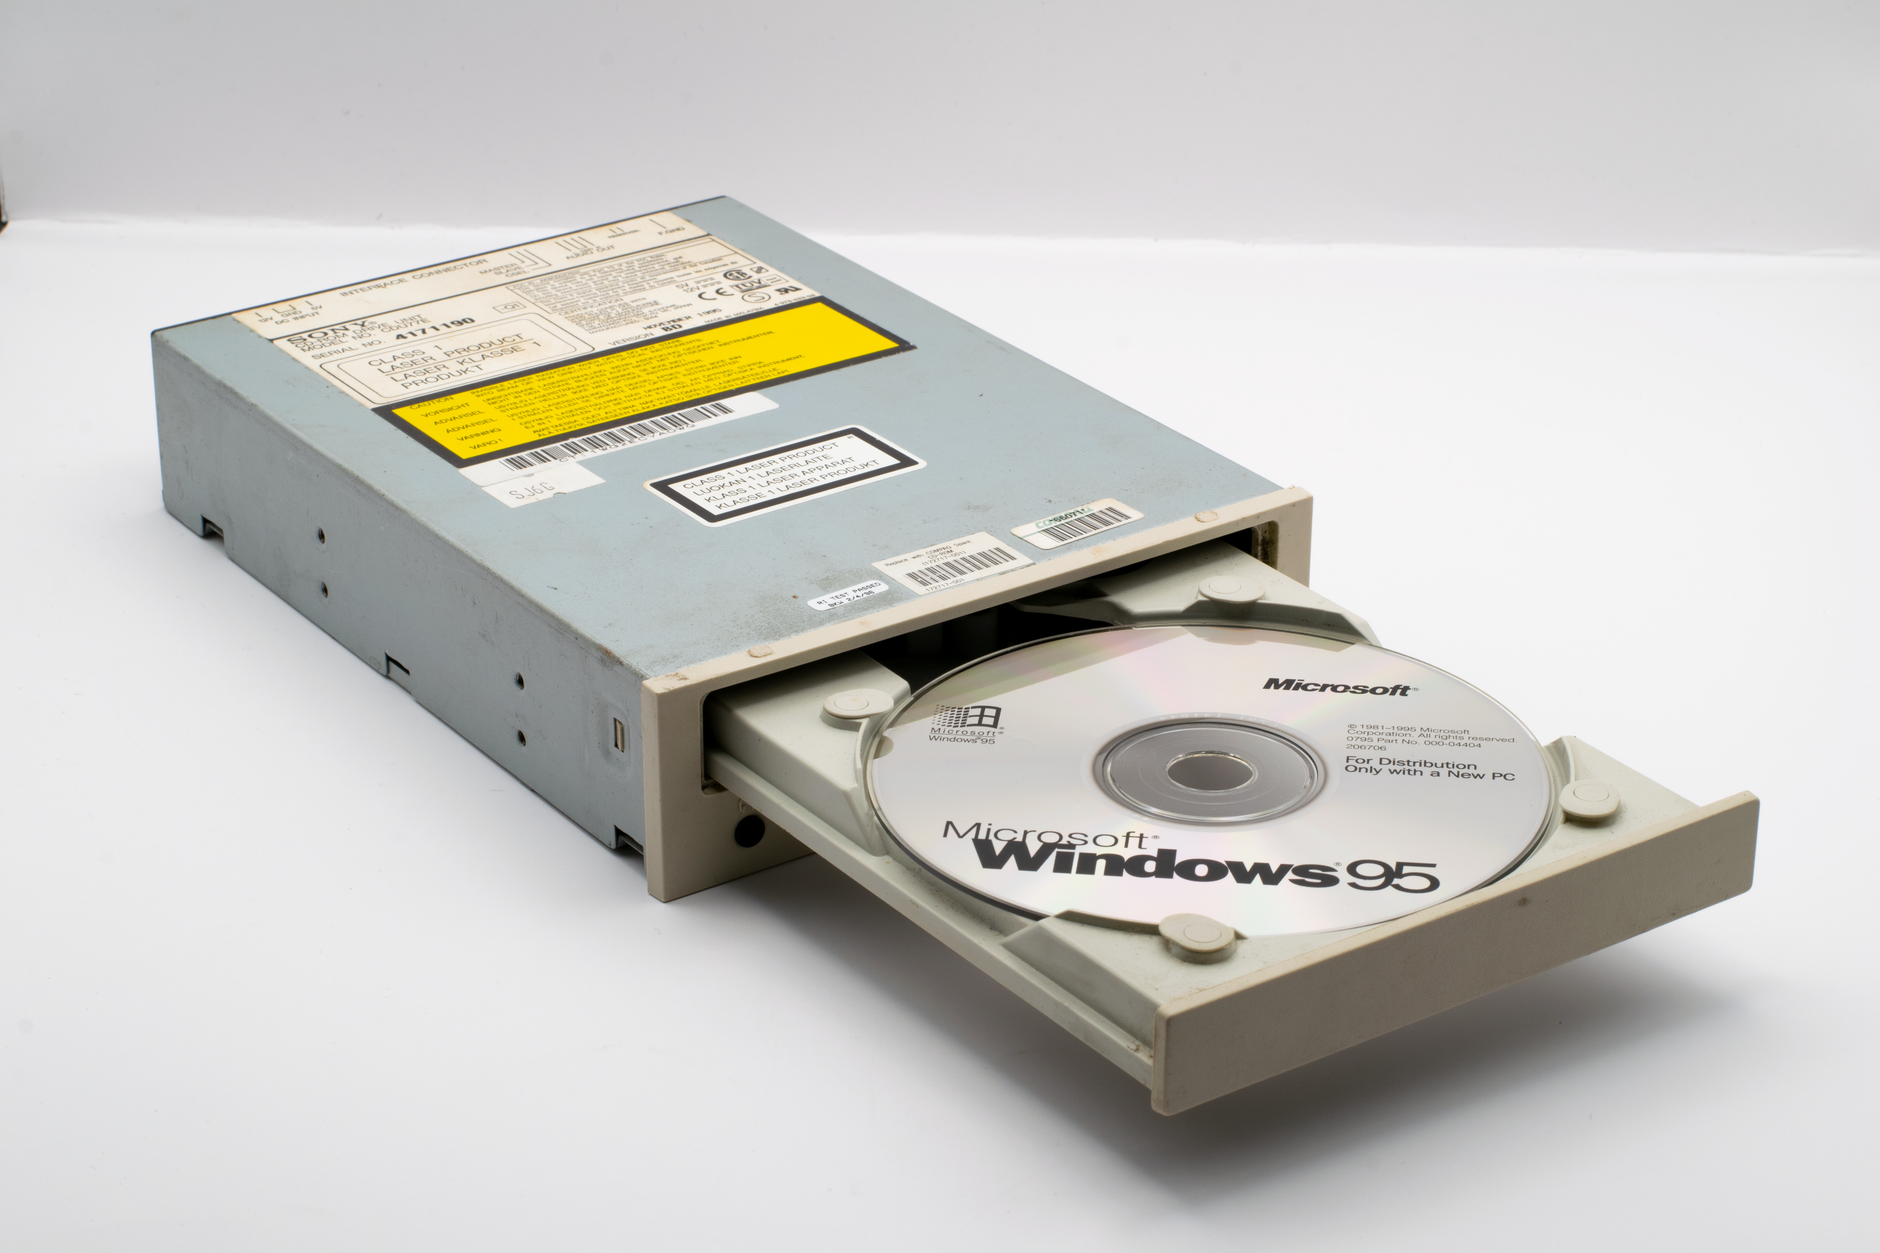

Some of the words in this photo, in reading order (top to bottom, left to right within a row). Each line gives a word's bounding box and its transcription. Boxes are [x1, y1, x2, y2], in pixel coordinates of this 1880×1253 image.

[479, 263, 517, 274] MASTER
[340, 278, 407, 297] INTERFACE
[412, 259, 488, 279] CONNECTOR
[292, 312, 319, 321] INPUT
[643, 316, 691, 330] NOVEMBER
[292, 333, 348, 349] CD-ROM
[352, 323, 393, 335] DRIVE
[394, 314, 426, 324] UNIT
[300, 339, 344, 352] MODEL
[381, 318, 431, 332] CDU77E
[311, 347, 358, 359] SERIAL
[396, 318, 475, 340] 4171190
[609, 332, 654, 346] VERSION
[368, 350, 425, 366] CLASS
[377, 356, 436, 374] LASER
[443, 334, 523, 357] PRODUCT
[390, 364, 449, 382] LASER
[456, 345, 525, 366] KLASSE
[401, 364, 483, 389] PRODUKT
[407, 396, 454, 409] CAUTION
[421, 403, 470, 417] VORSICHT
[434, 411, 482, 425] ADVARSEL
[446, 418, 497, 433] ADVARSEL
[457, 428, 501, 441] VARNING
[469, 441, 498, 449] VARO
[683, 475, 722, 489] CLASS
[736, 460, 778, 474] LASER
[779, 443, 838, 462] PRODUCT
[693, 478, 747, 496] LUOKAN
[757, 454, 832, 478] LASERLAITE
[704, 489, 745, 503] KLASS
[757, 473, 800, 488] LASER
[801, 457, 854, 476] APPARAT
[715, 492, 766, 509] KLASSE
[776, 478, 819, 492] LASER
[819, 460, 879, 480] PRODUKT
[830, 592, 849, 600] TEST
[852, 582, 881, 593] PASSED
[1347, 728, 1415, 738] Corporation.
[1434, 733, 1465, 741] rights
[1468, 735, 1518, 743] reserved.
[1420, 726, 1470, 735] Microsoft
[1346, 735, 1374, 743] 0795
[1424, 740, 1482, 748] 000-04404
[1346, 743, 1387, 751] 206706
[1346, 755, 1374, 765] For
[1379, 757, 1478, 770] Distribution
[1344, 764, 1383, 776] Only
[1388, 766, 1423, 777] with
[1430, 769, 1441, 777] a
[1447, 770, 1486, 780] New
[1492, 772, 1516, 781] PC
[1347, 859, 1441, 894] 95
